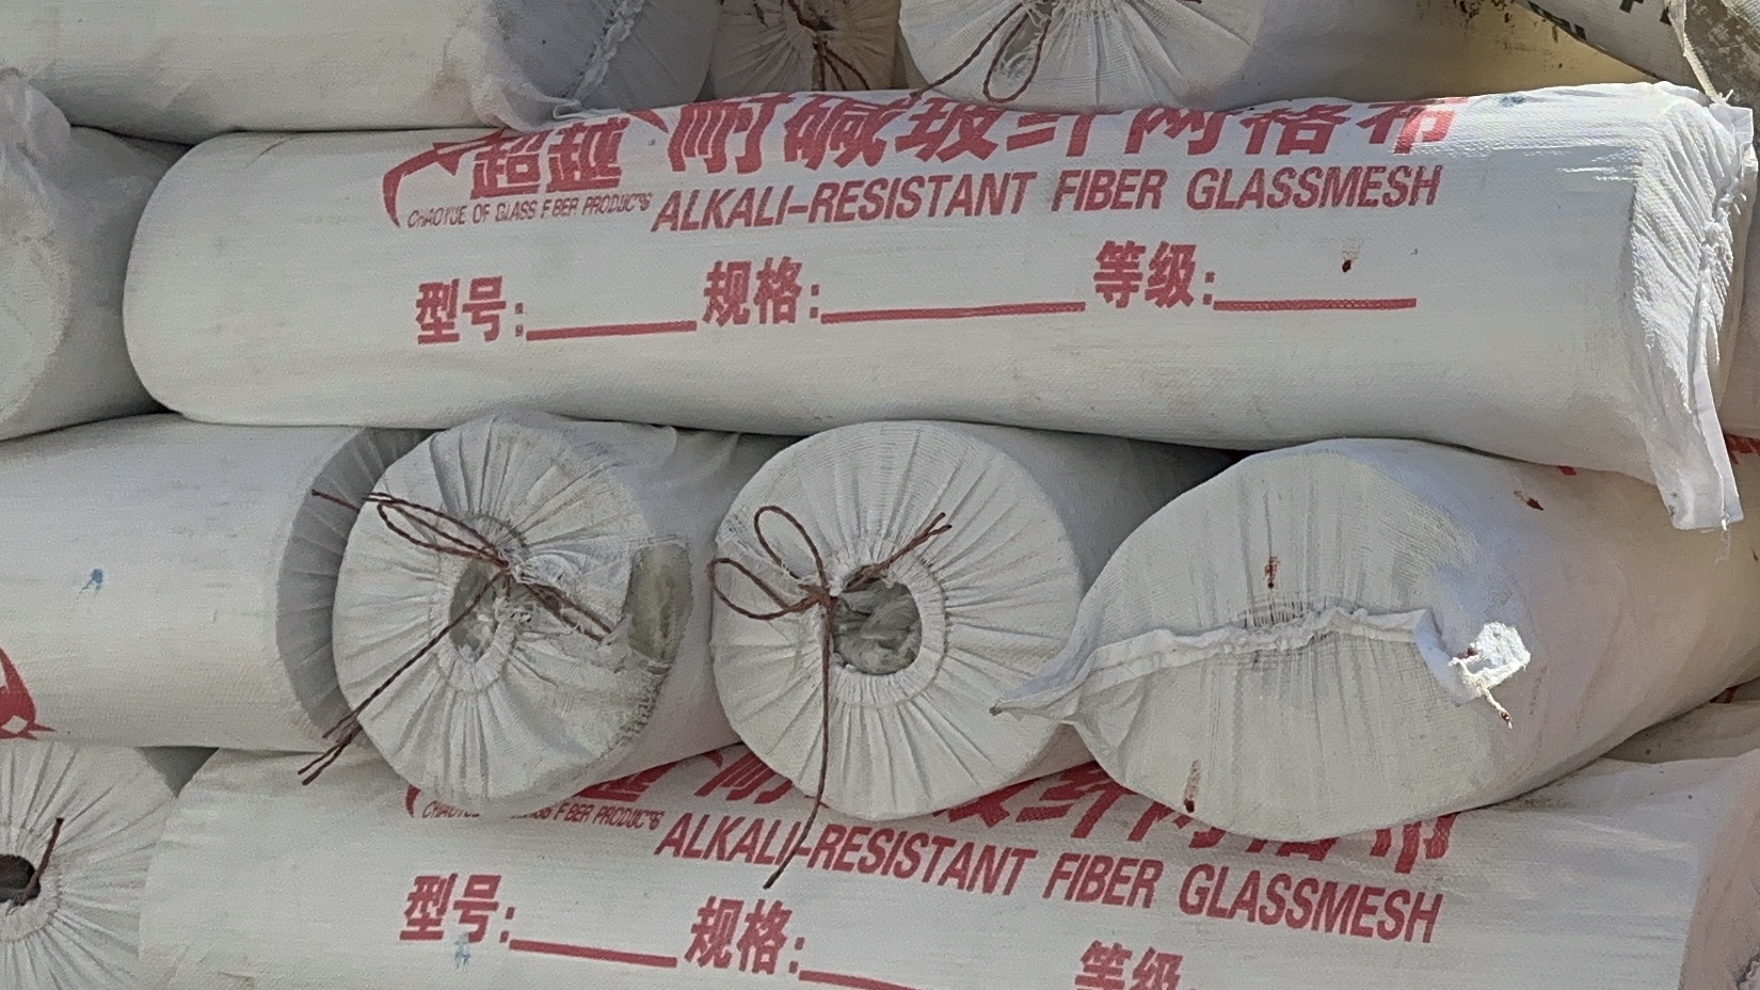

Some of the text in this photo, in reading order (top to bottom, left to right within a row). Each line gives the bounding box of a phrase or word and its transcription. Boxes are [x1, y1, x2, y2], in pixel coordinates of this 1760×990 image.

[471, 117, 630, 200] 超越
[650, 163, 1444, 232] ALKALI-RESISTANT FIBER GLASSMESH
[472, 203, 491, 225] OF
[540, 196, 579, 220] FBER
[416, 239, 1216, 345] 型号: 规格: 等级:
[399, 873, 516, 944] 型号:
[684, 895, 806, 975] 规格:
[654, 812, 1038, 899] ALKALI-RESISTANT
[1042, 851, 1164, 909] FIBER
[1178, 863, 1444, 944] GLASSMESH
